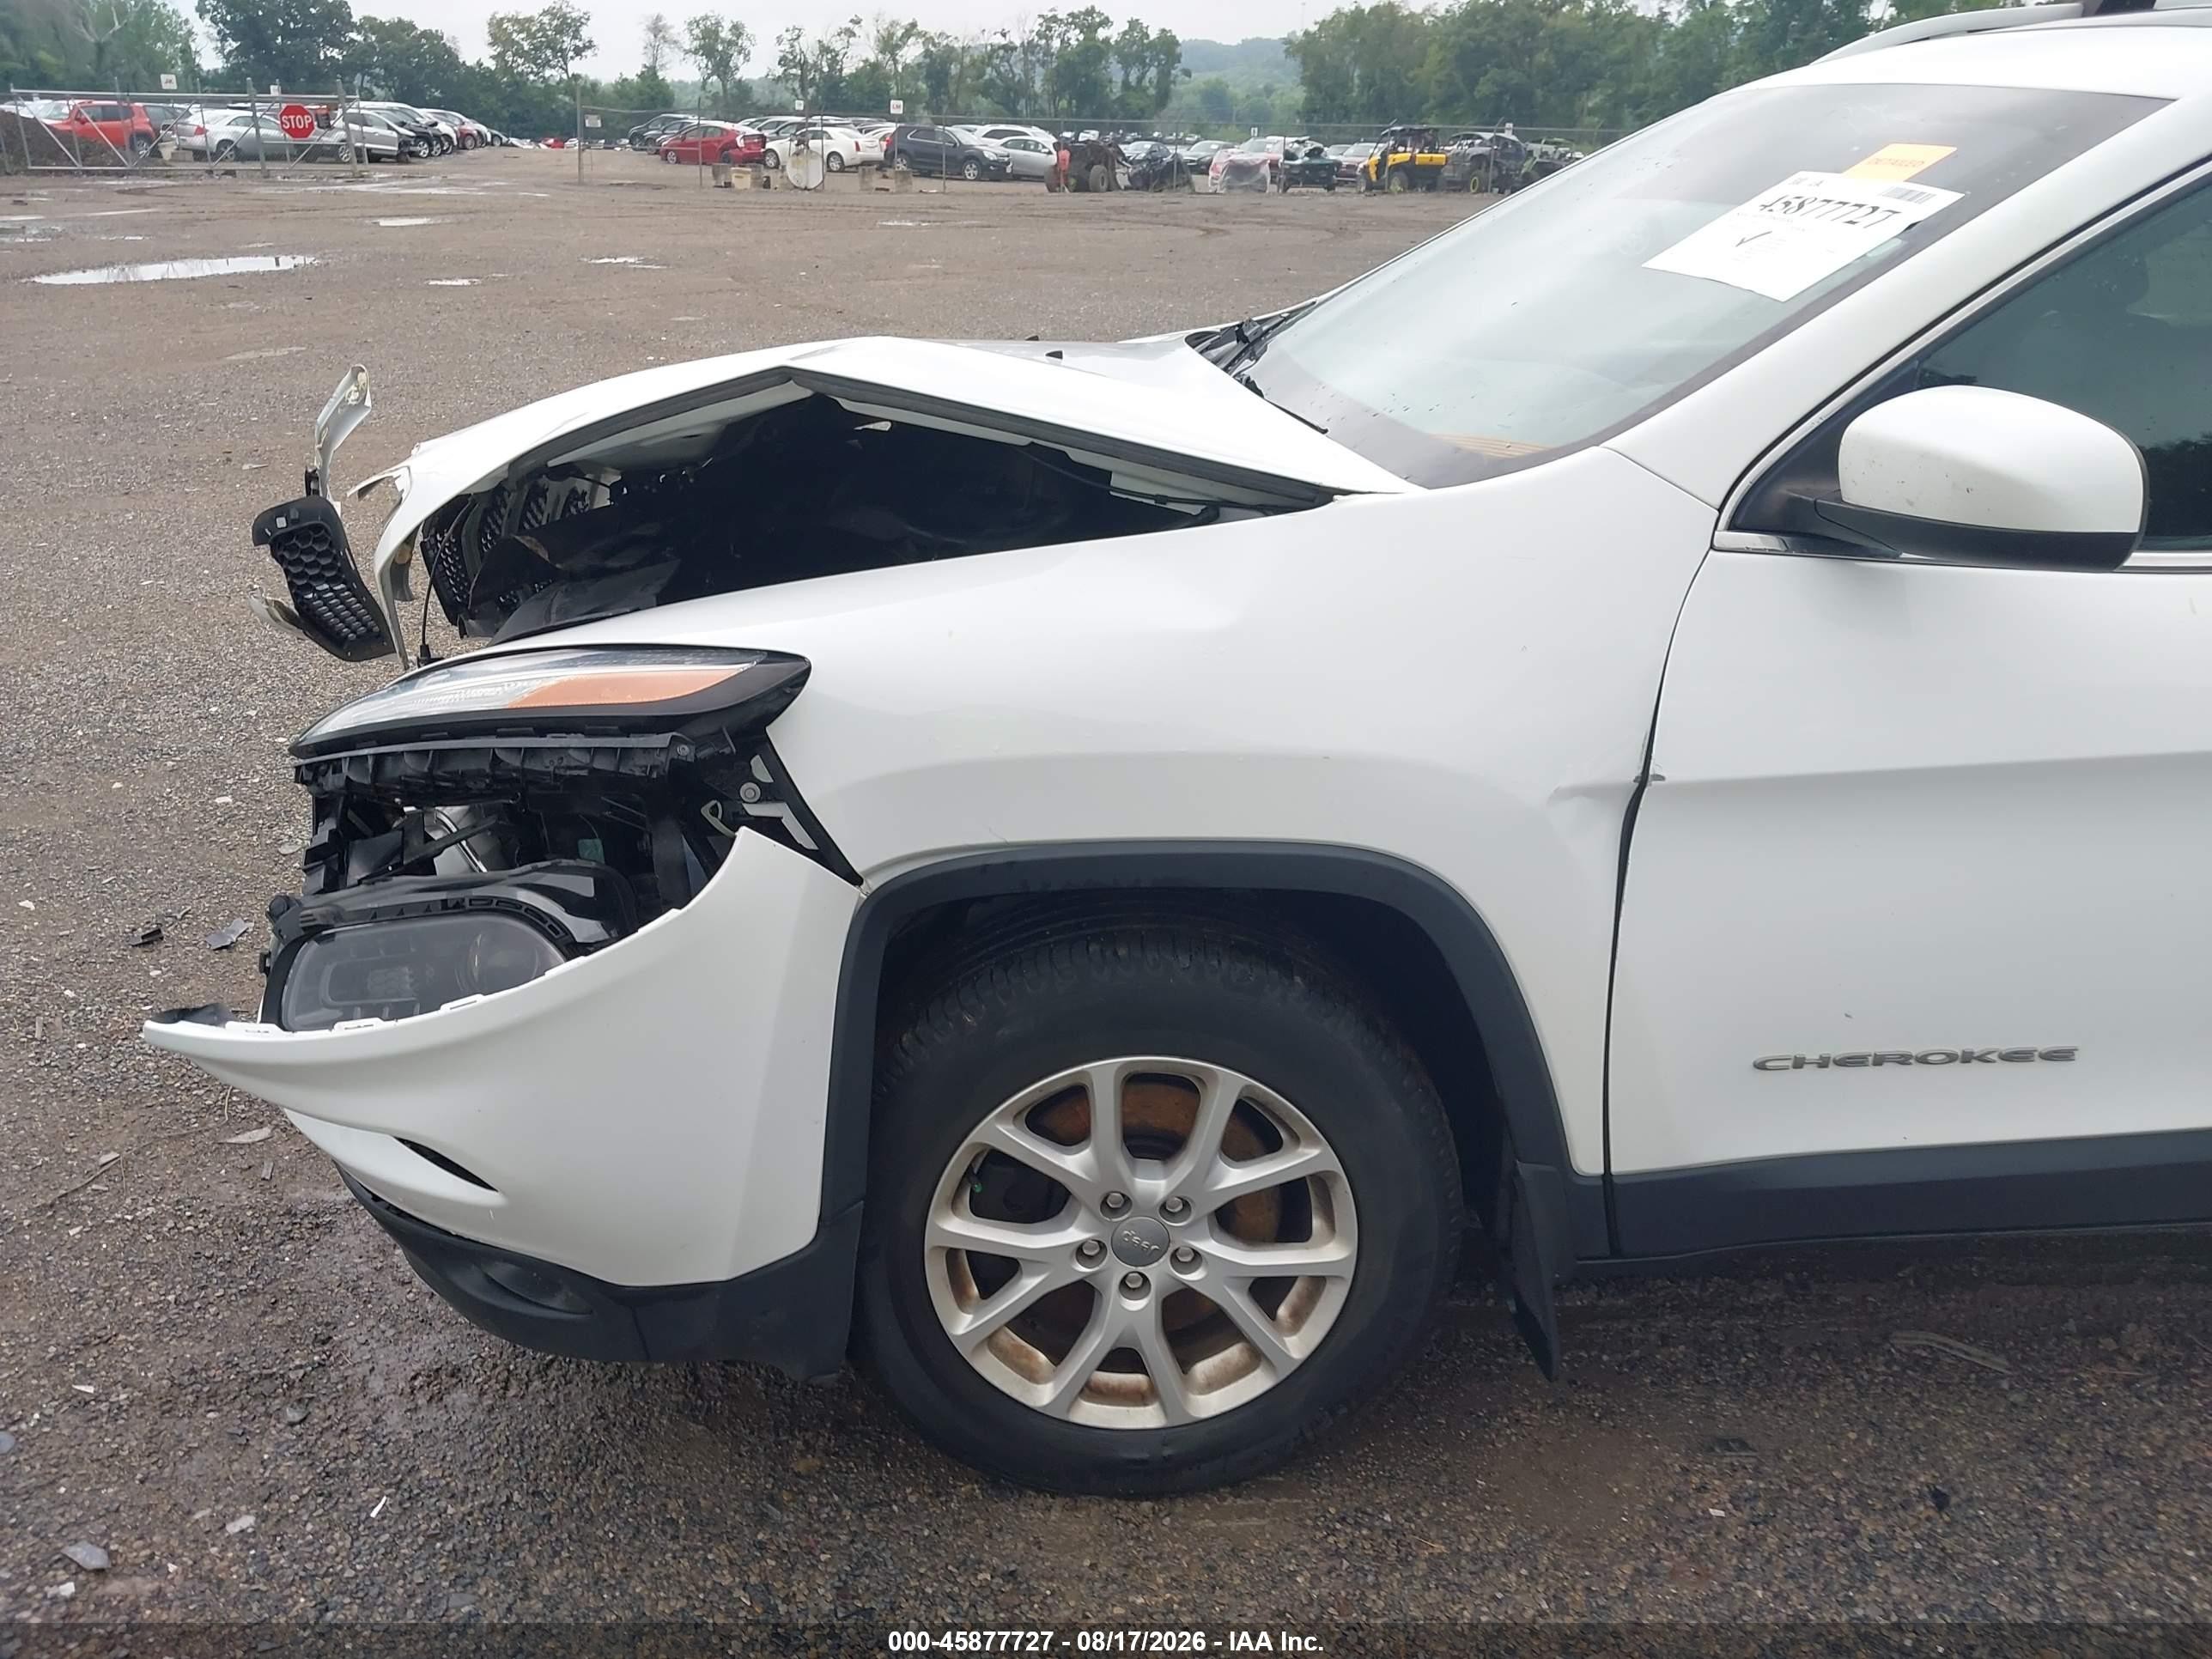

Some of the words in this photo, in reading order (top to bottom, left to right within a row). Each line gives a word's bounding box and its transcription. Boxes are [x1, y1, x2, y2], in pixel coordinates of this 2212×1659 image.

[282, 115, 312, 130] STOP
[1759, 194, 1903, 228] 45877727
[1753, 1045, 2079, 1071] CHEROKEE
